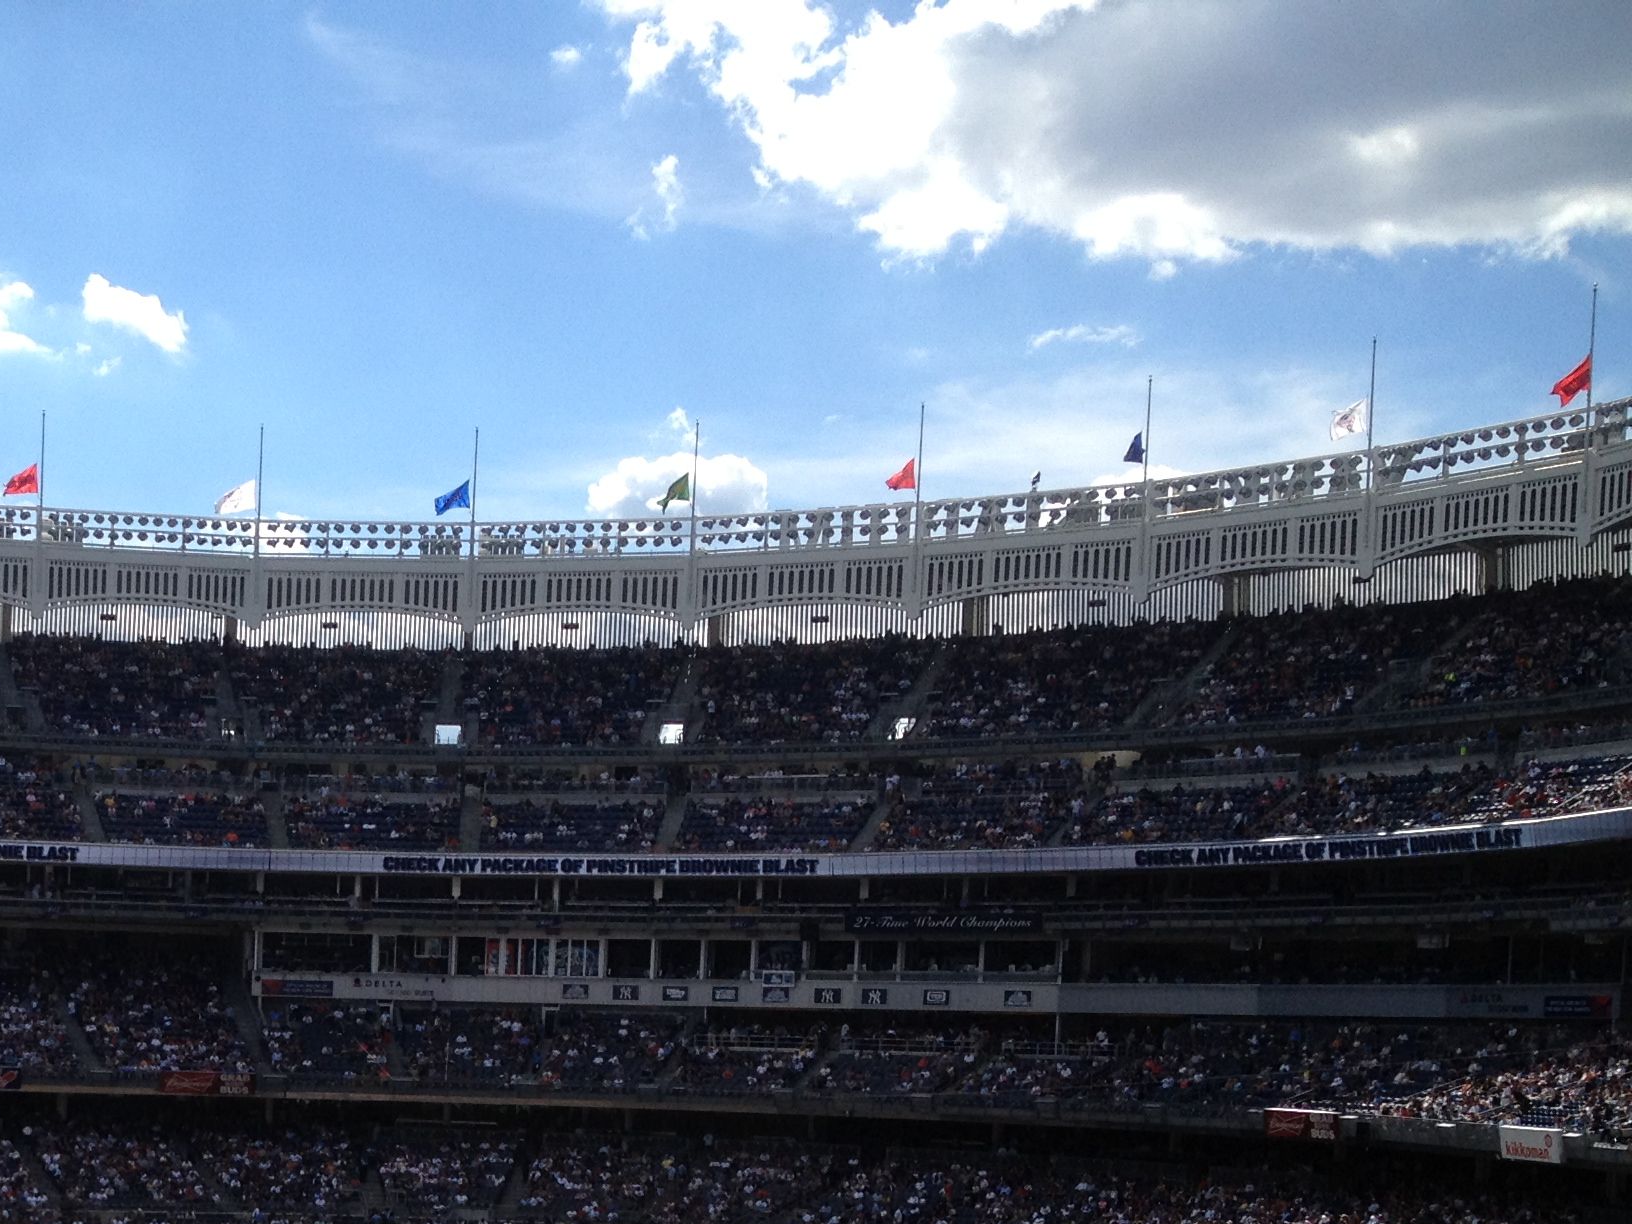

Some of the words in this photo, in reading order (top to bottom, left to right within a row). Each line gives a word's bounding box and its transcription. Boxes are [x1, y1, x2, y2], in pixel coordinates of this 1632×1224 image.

[27, 846, 79, 861] BLAST
[1135, 849, 1194, 866] CHECK
[1196, 848, 1230, 864] ANY
[1232, 843, 1303, 863] PACKAGE
[1305, 842, 1327, 859] OF
[1329, 837, 1409, 859] PINSTRIPE
[383, 856, 441, 872] CHECK
[443, 857, 478, 873] ANY
[481, 857, 559, 873] PACKAGE
[561, 858, 585, 874] OF
[586, 859, 676, 874] PINSTRIPE
[678, 859, 761, 874] BROWNIE
[763, 859, 818, 874] BLAST
[913, 914, 958, 930] World
[960, 914, 1032, 932] Champions
[365, 980, 402, 988] DELTA
[219, 1086, 249, 1095] BUDS
[1505, 1141, 1550, 1159] kikkoman
